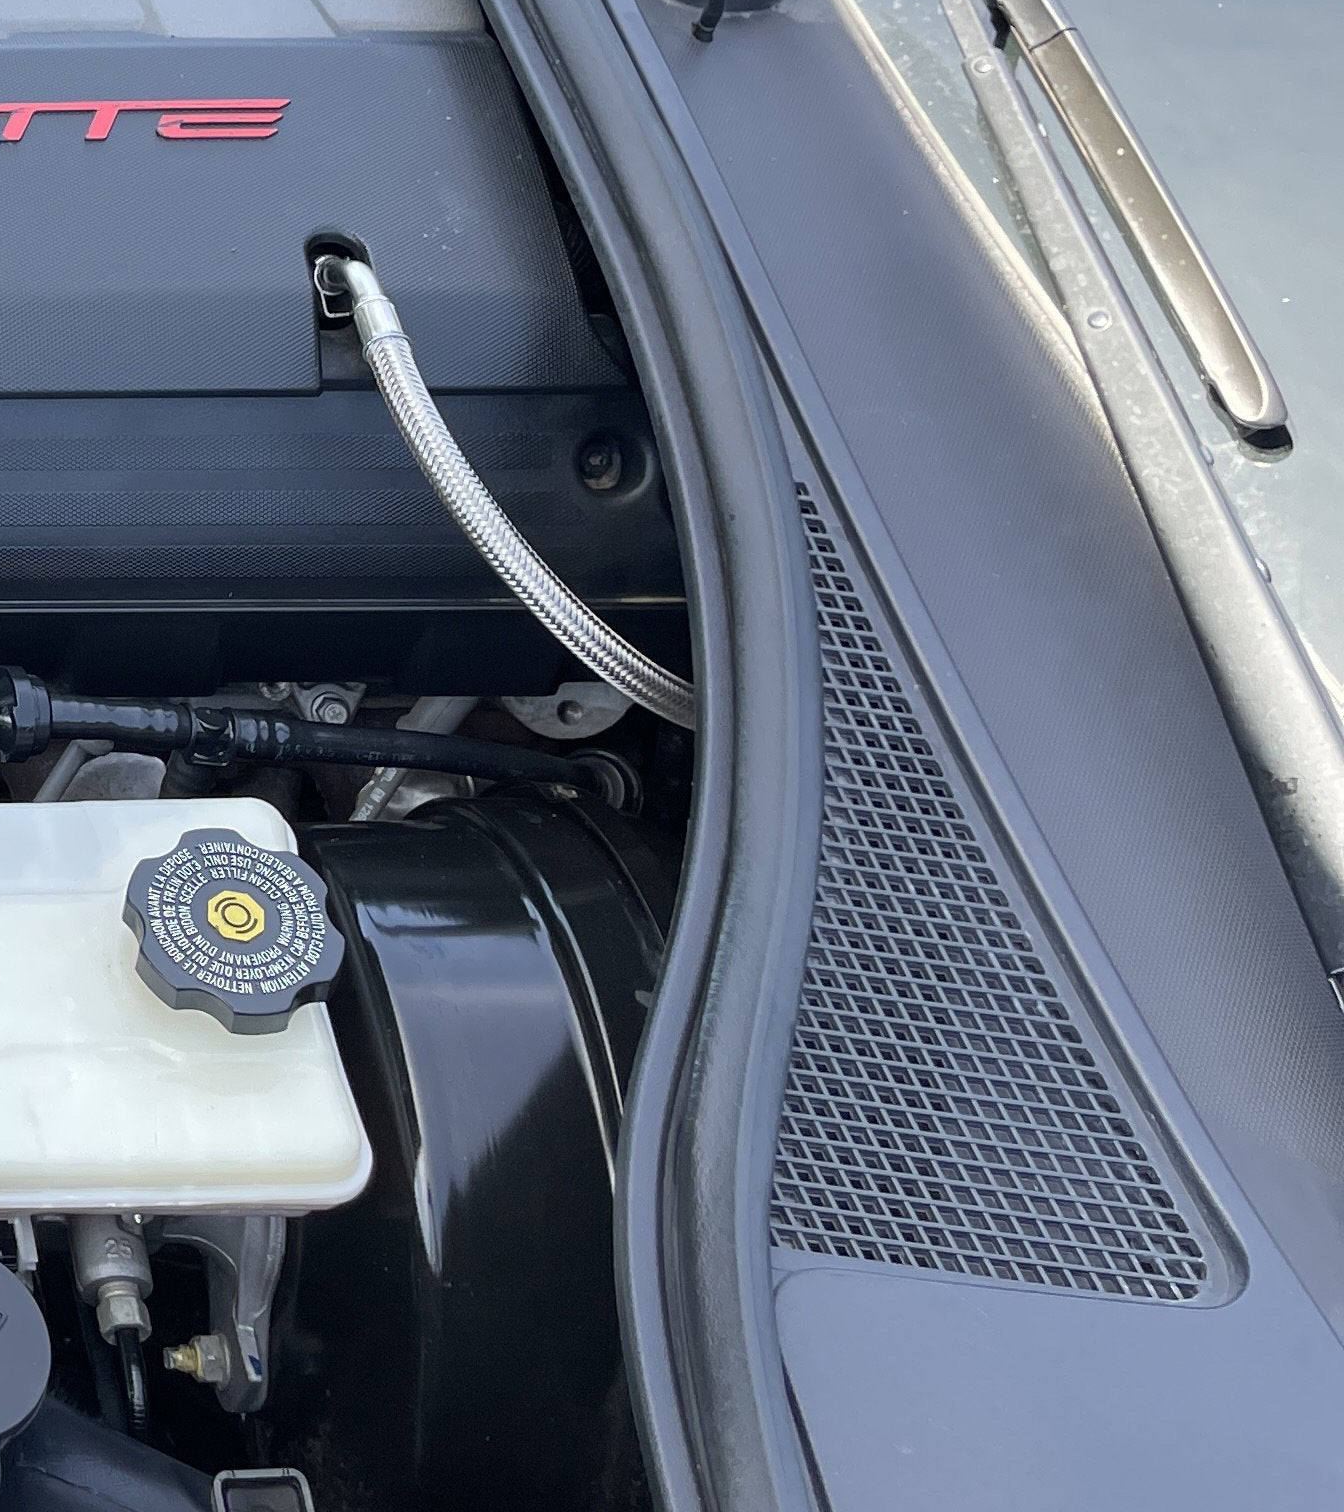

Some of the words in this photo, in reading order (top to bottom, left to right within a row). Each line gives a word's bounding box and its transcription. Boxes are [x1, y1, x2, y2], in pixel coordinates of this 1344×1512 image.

[177, 859, 202, 880] DOT3
[204, 854, 228, 867] ONLY
[231, 855, 252, 868] USE
[259, 853, 297, 881] SEALED
[152, 875, 167, 888] LA
[210, 867, 248, 880] FILLER
[291, 875, 304, 886] A
[164, 878, 183, 903] FREIN
[249, 874, 281, 900] CLEAN
[147, 888, 161, 917] AVANT
[298, 885, 320, 912] FROM
[162, 905, 176, 918] DE
[178, 906, 198, 935] BIDON
[293, 903, 310, 939] BEFORE
[310, 913, 326, 940] FLUID
[150, 919, 185, 962] BOUCHON
[289, 936, 306, 956] CAP
[192, 951, 209, 965] DU
[219, 945, 282, 966] PROVENANT
[304, 940, 324, 965] DOT3
[181, 960, 197, 974] LE
[209, 963, 233, 976] QUE
[197, 968, 253, 994] NETTOYER
